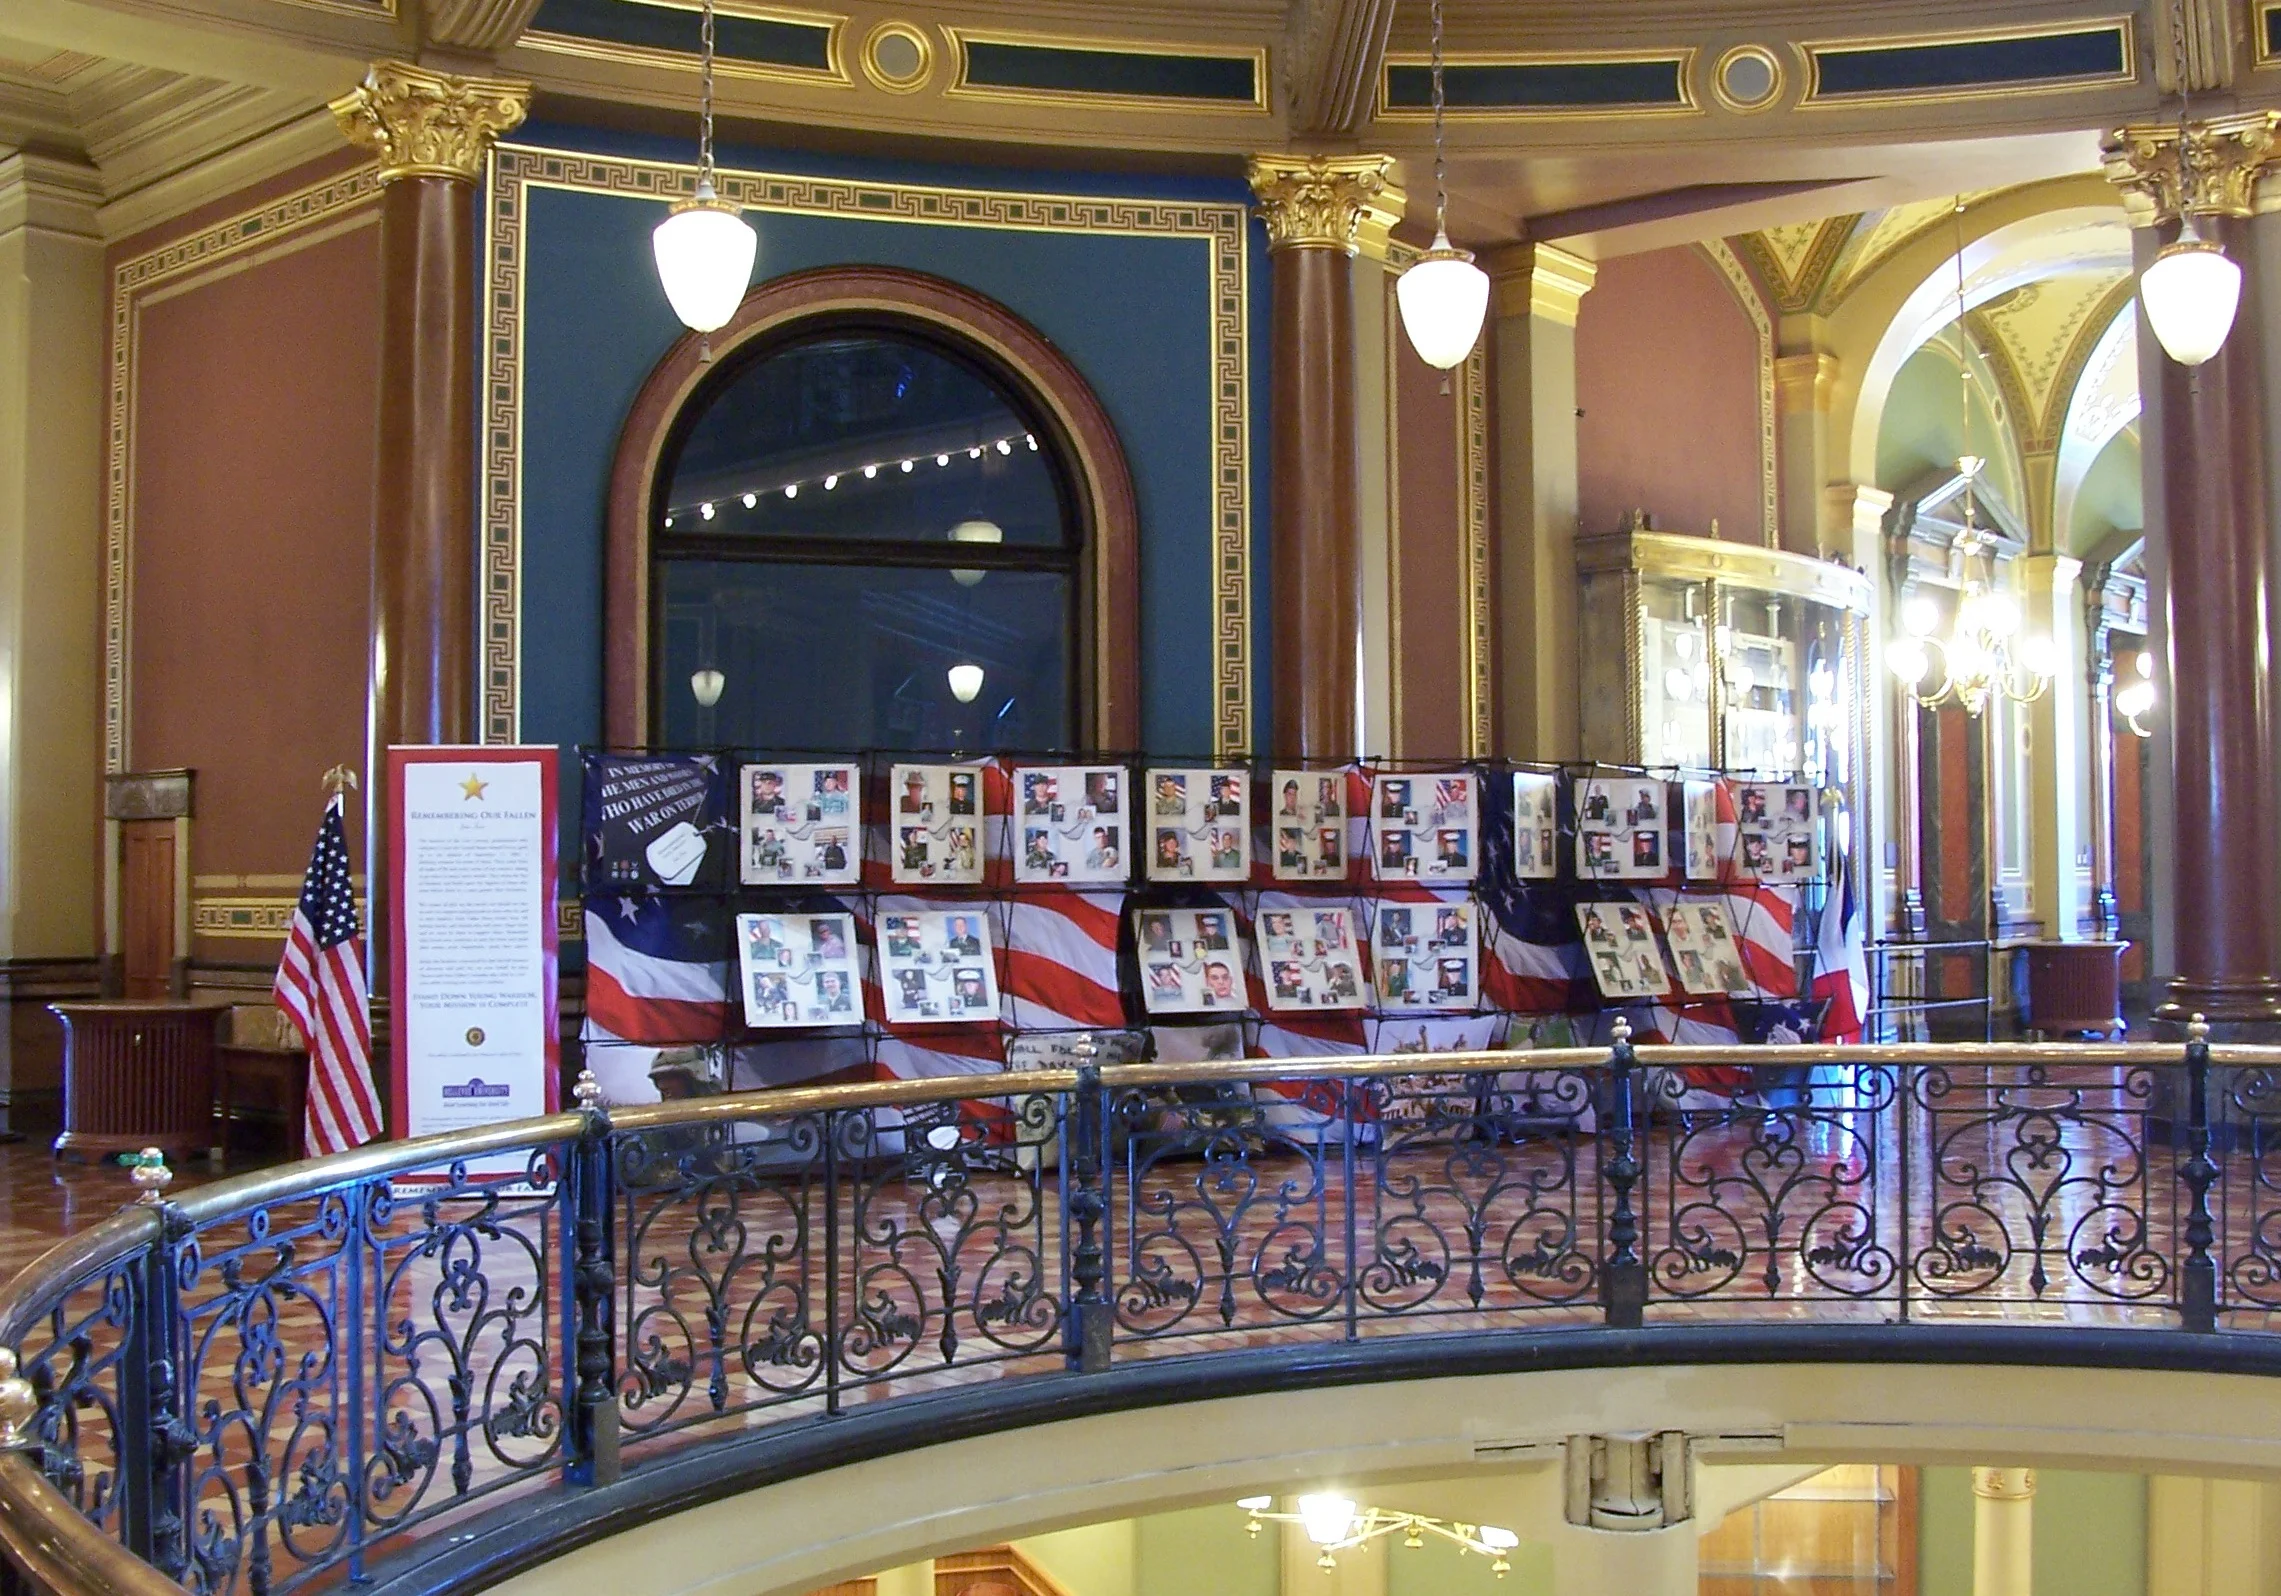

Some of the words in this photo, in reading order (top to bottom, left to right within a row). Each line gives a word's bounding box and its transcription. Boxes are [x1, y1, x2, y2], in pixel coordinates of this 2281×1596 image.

[607, 767, 624, 778] IN
[624, 762, 667, 775] MEMORY
[622, 778, 650, 791] MEN
[630, 788, 664, 811] HAVE
[480, 811, 502, 819] OUR
[504, 811, 537, 819] FALLEN
[627, 809, 662, 834] WAR
[660, 805, 678, 819] ON
